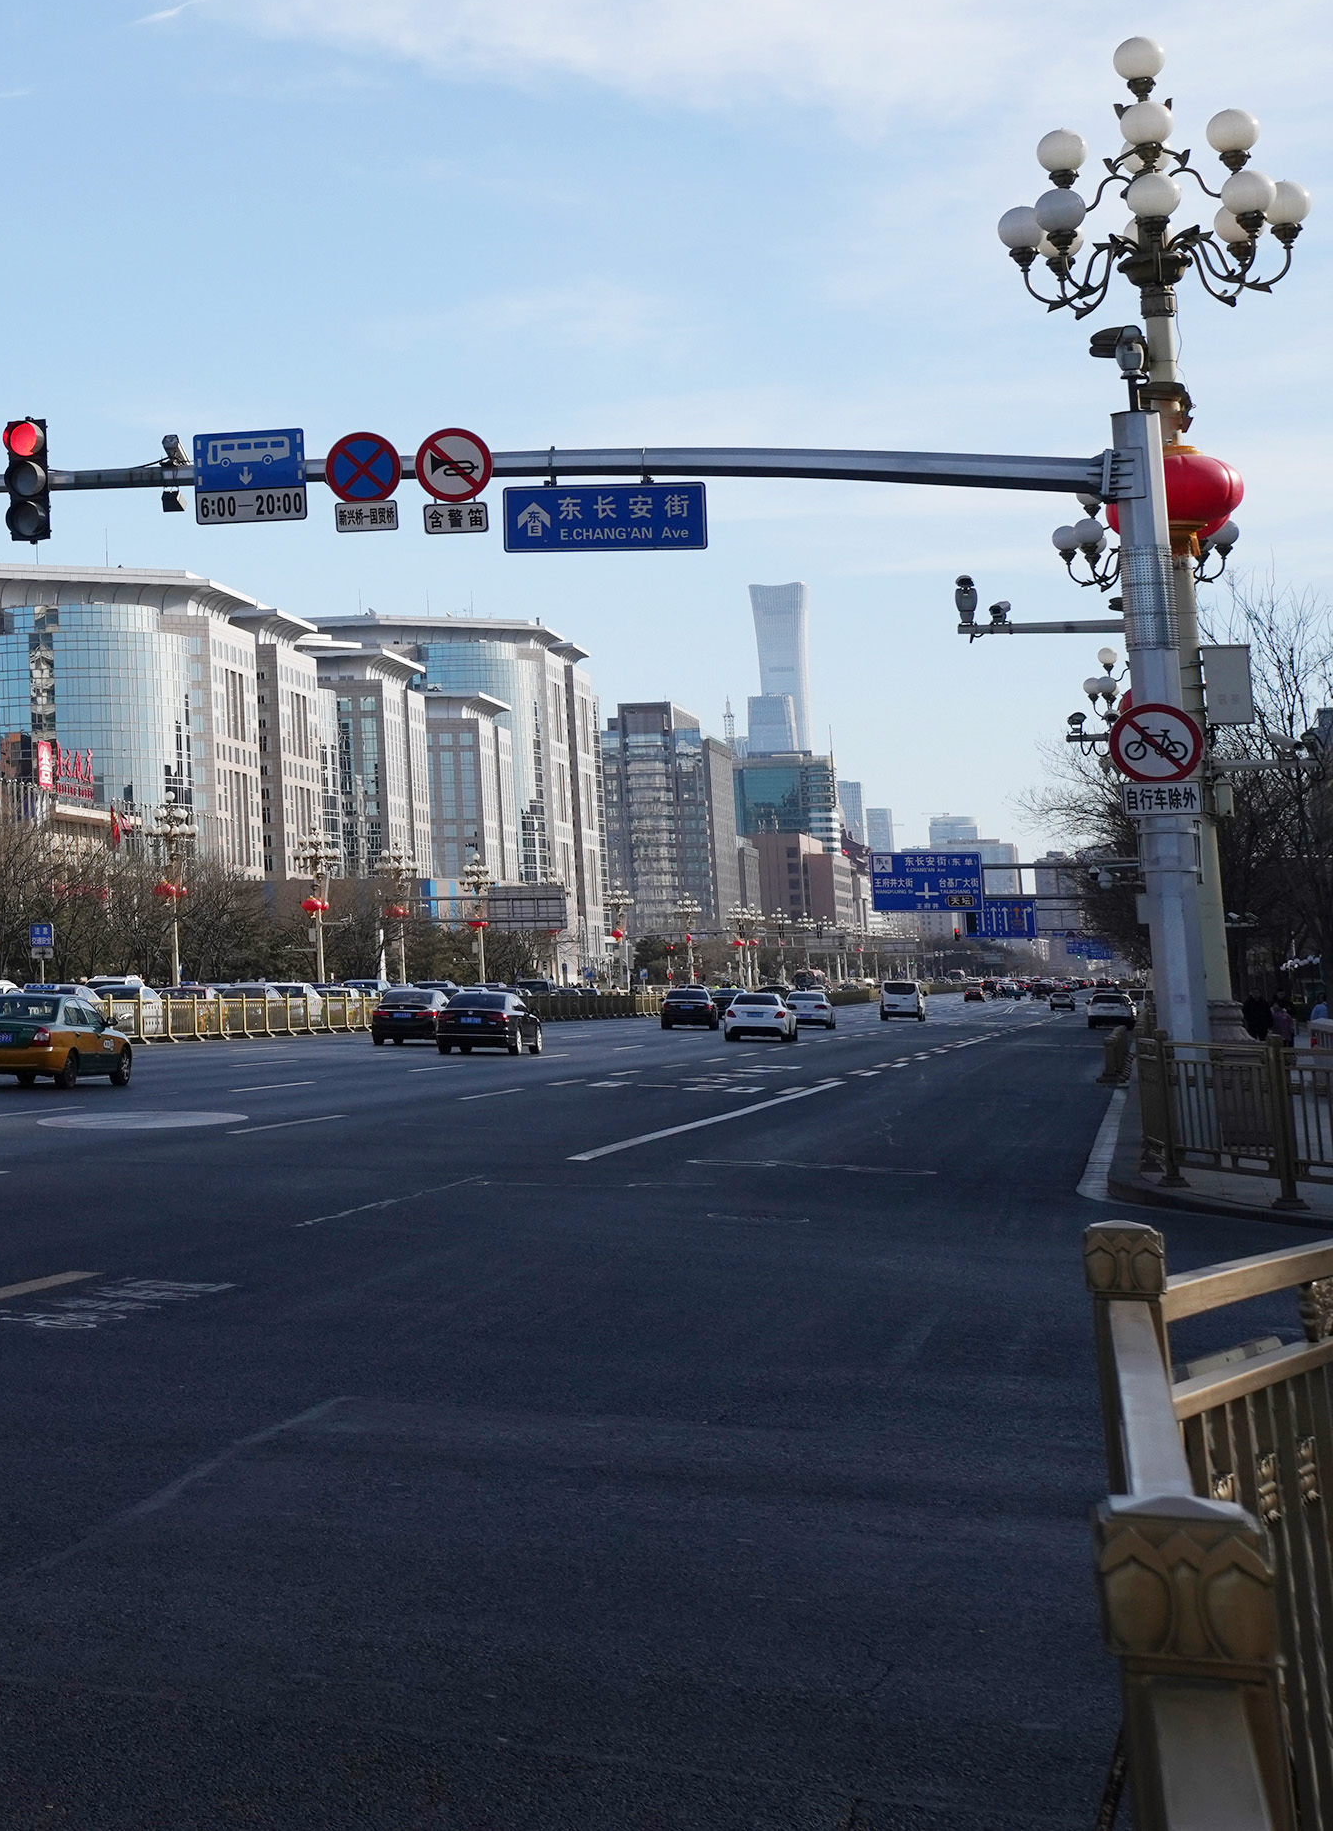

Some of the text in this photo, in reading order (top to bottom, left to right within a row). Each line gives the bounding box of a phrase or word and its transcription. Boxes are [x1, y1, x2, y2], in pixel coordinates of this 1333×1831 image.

[428, 507, 485, 529] 含警笛
[557, 494, 690, 520] 东长安街
[559, 526, 689, 540] E.CHANG'AN Ave
[1126, 786, 1197, 812] 自行车除外
[874, 878, 913, 888] 王府井大街
